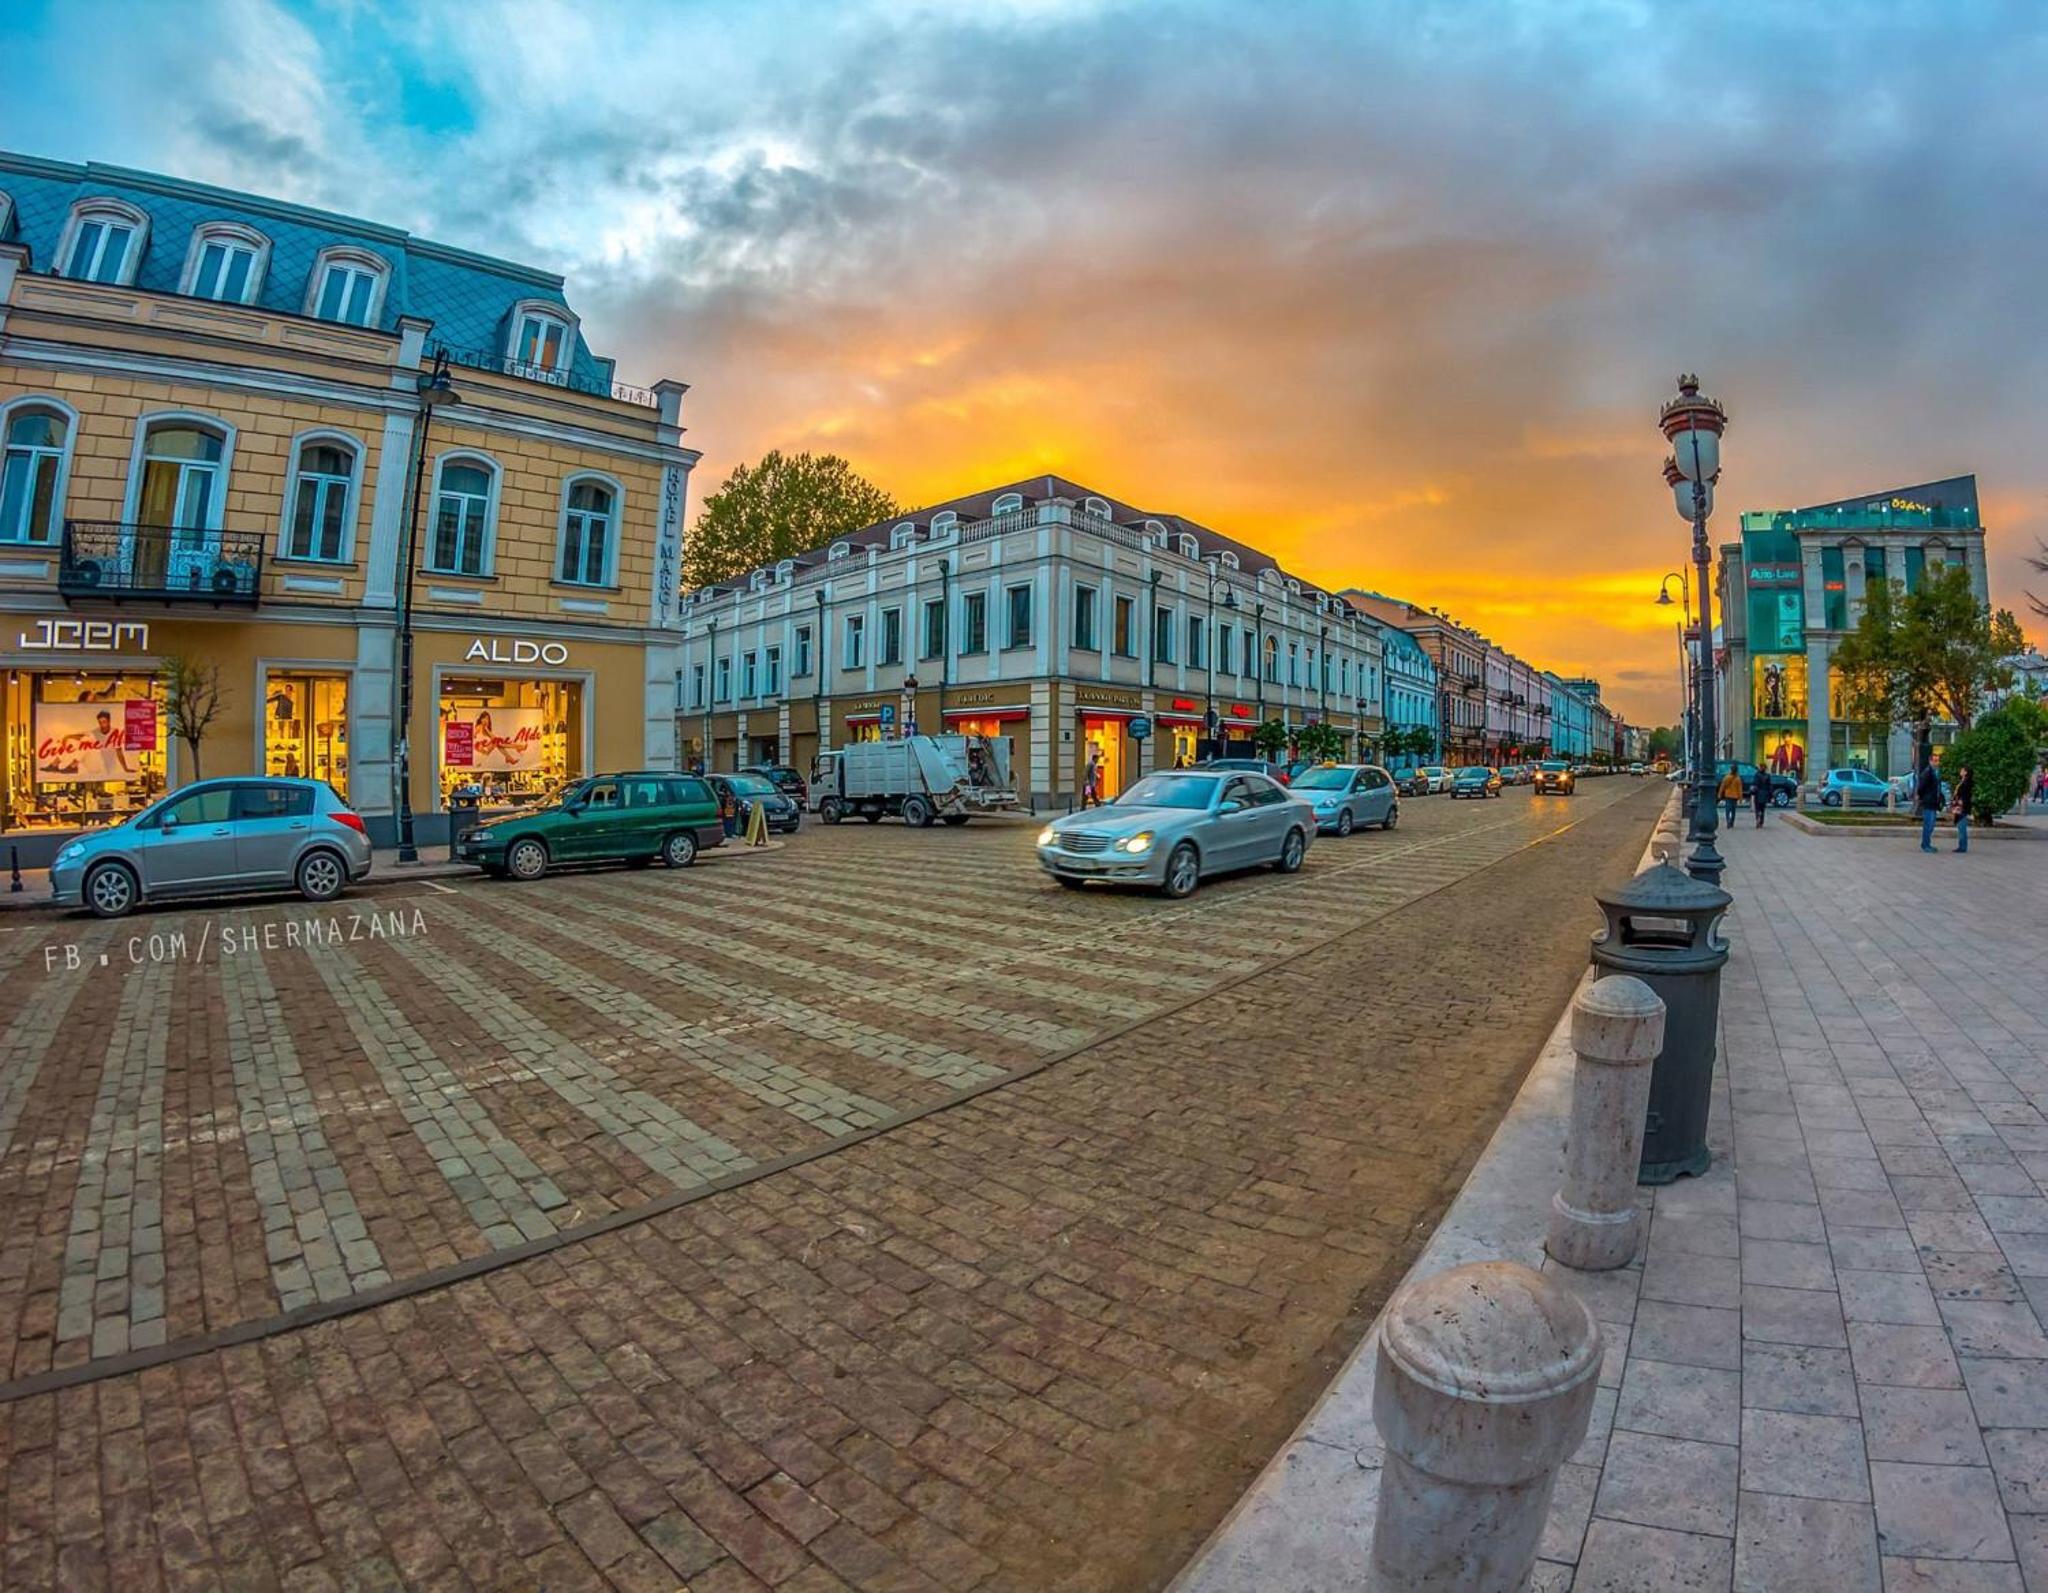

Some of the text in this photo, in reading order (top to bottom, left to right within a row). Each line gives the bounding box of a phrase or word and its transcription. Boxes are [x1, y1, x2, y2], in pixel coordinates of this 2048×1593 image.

[465, 639, 569, 665] ALDO
[883, 707, 893, 721] P
[38, 737, 75, 759] Give
[78, 740, 102, 751] me
